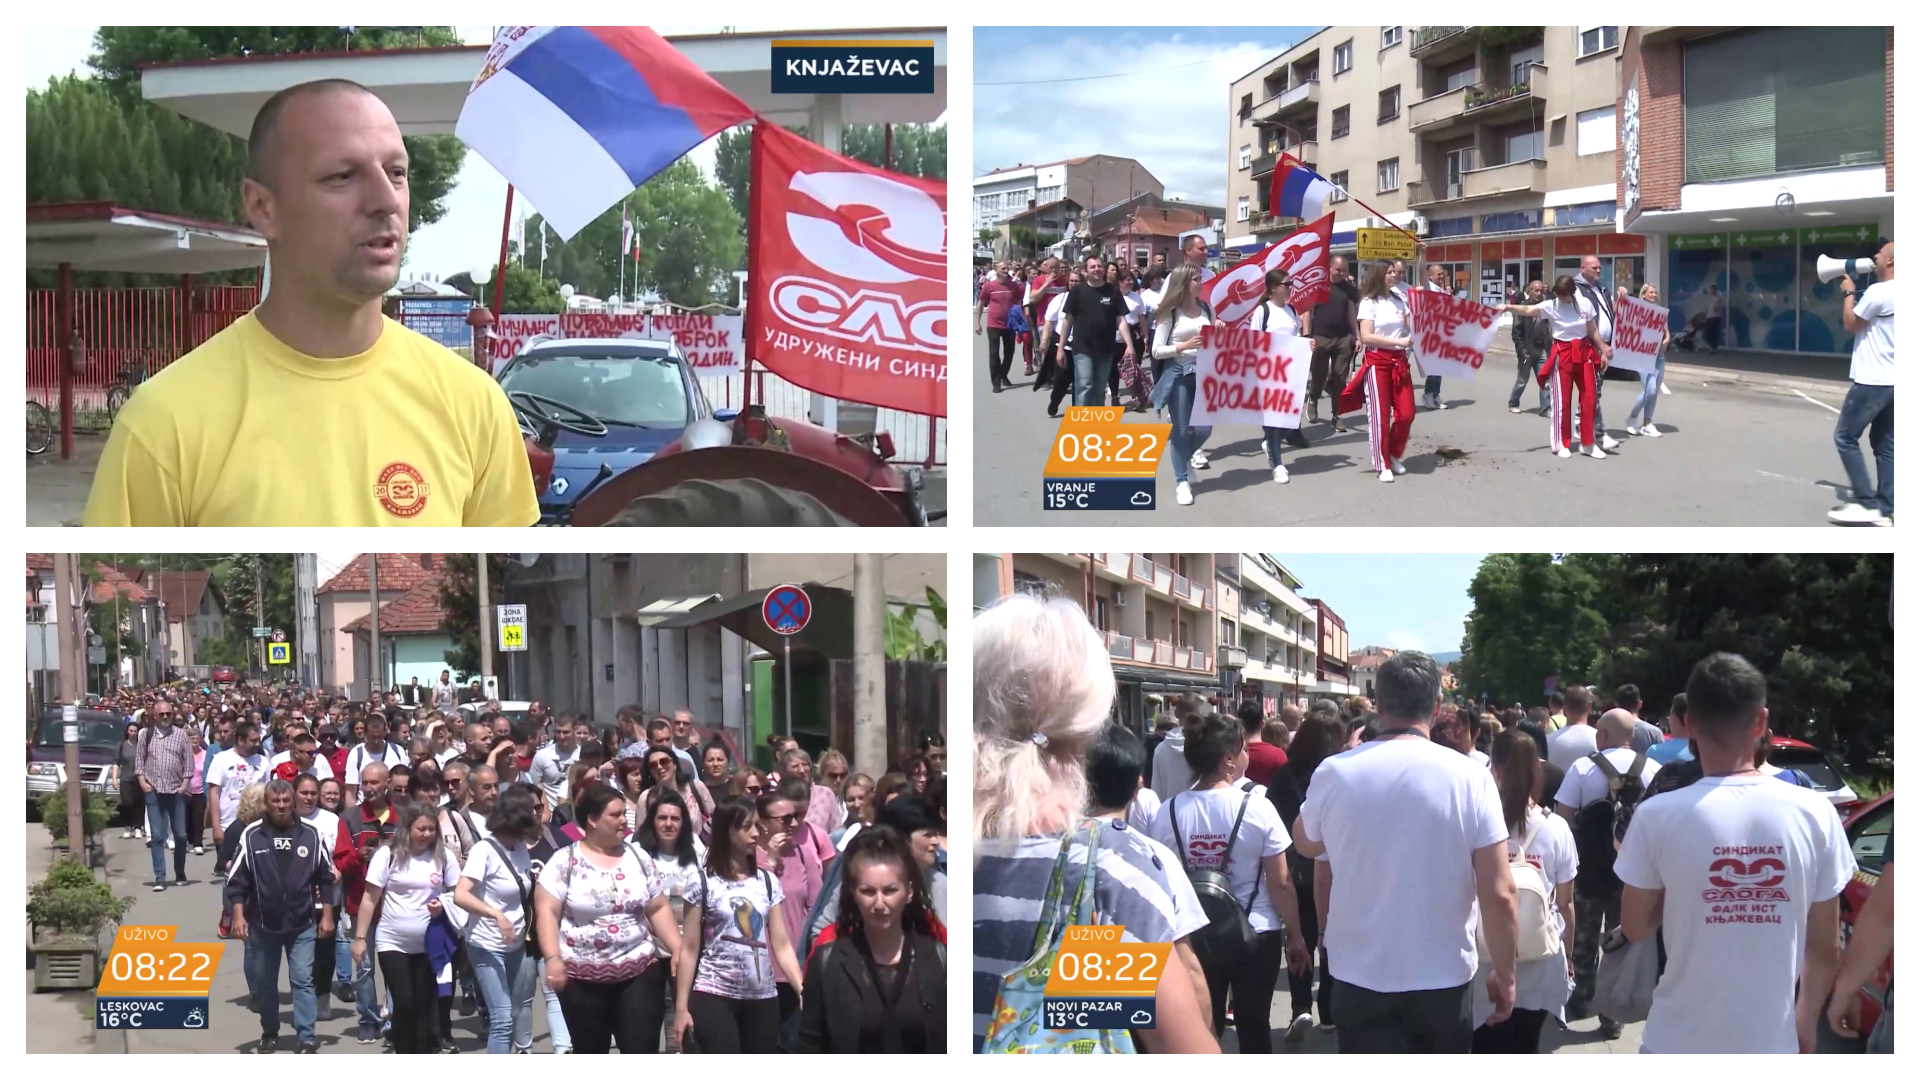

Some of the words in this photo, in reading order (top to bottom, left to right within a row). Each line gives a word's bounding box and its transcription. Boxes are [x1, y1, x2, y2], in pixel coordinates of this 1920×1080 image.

[1615, 297, 1667, 333] СТИМУЛАН
[765, 326, 880, 371] УДРУЖЕНИ
[1214, 349, 1293, 383] ОБРОК
[503, 608, 522, 616] ЗОНА
[501, 616, 524, 624] ШКОЛЕ
[1712, 846, 1784, 856] СИНДИКАТ
[1702, 887, 1791, 903] СЛОГА
[1711, 904, 1748, 914] ФАЛК
[1751, 904, 1777, 914] ИСТ
[1705, 915, 1782, 925] КЊАЖЕВАЦ
